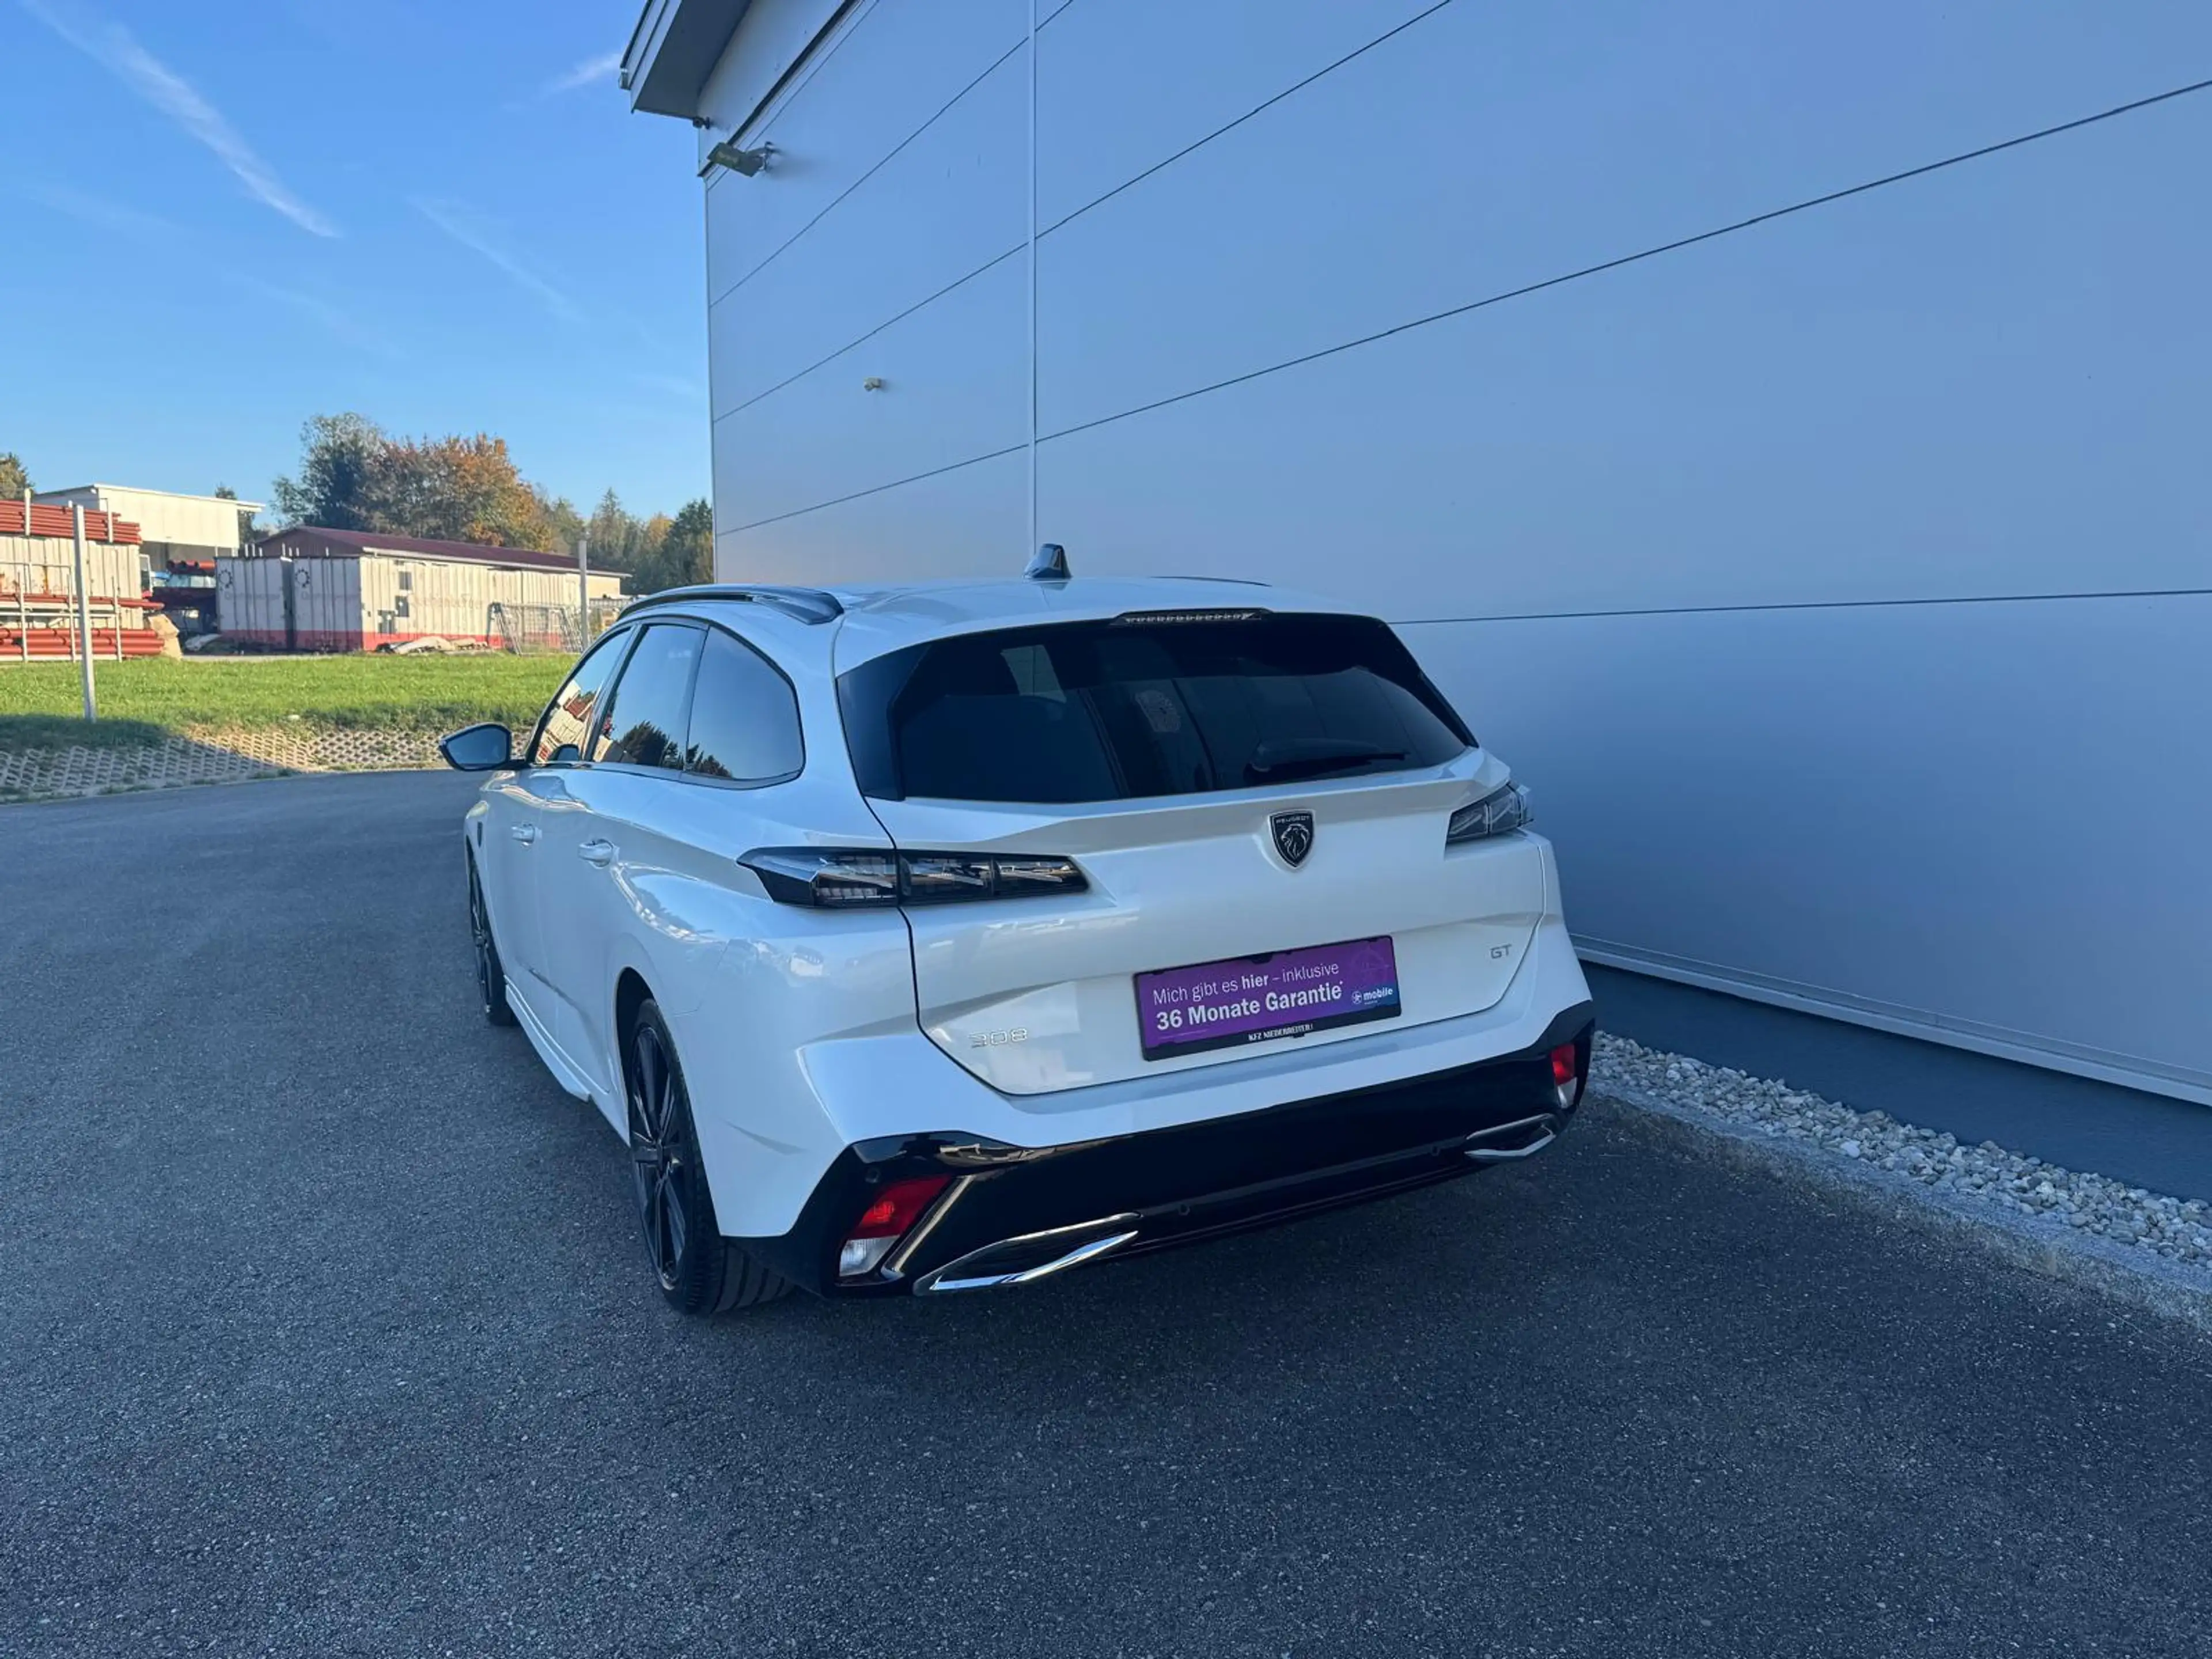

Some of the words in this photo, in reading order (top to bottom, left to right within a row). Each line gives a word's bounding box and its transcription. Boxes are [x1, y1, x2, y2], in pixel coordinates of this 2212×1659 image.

[1490, 944, 1512, 959] GT
[1153, 986, 1188, 1005] Mich
[1192, 982, 1218, 1002] gibt
[1222, 980, 1238, 993] es
[1241, 974, 1268, 990] hier
[1282, 963, 1339, 983] inklusive
[1363, 987, 1393, 1000] mobile
[1157, 1009, 1183, 1031] 36
[1188, 998, 1260, 1025] Monate
[968, 1028, 1027, 1048] 308
